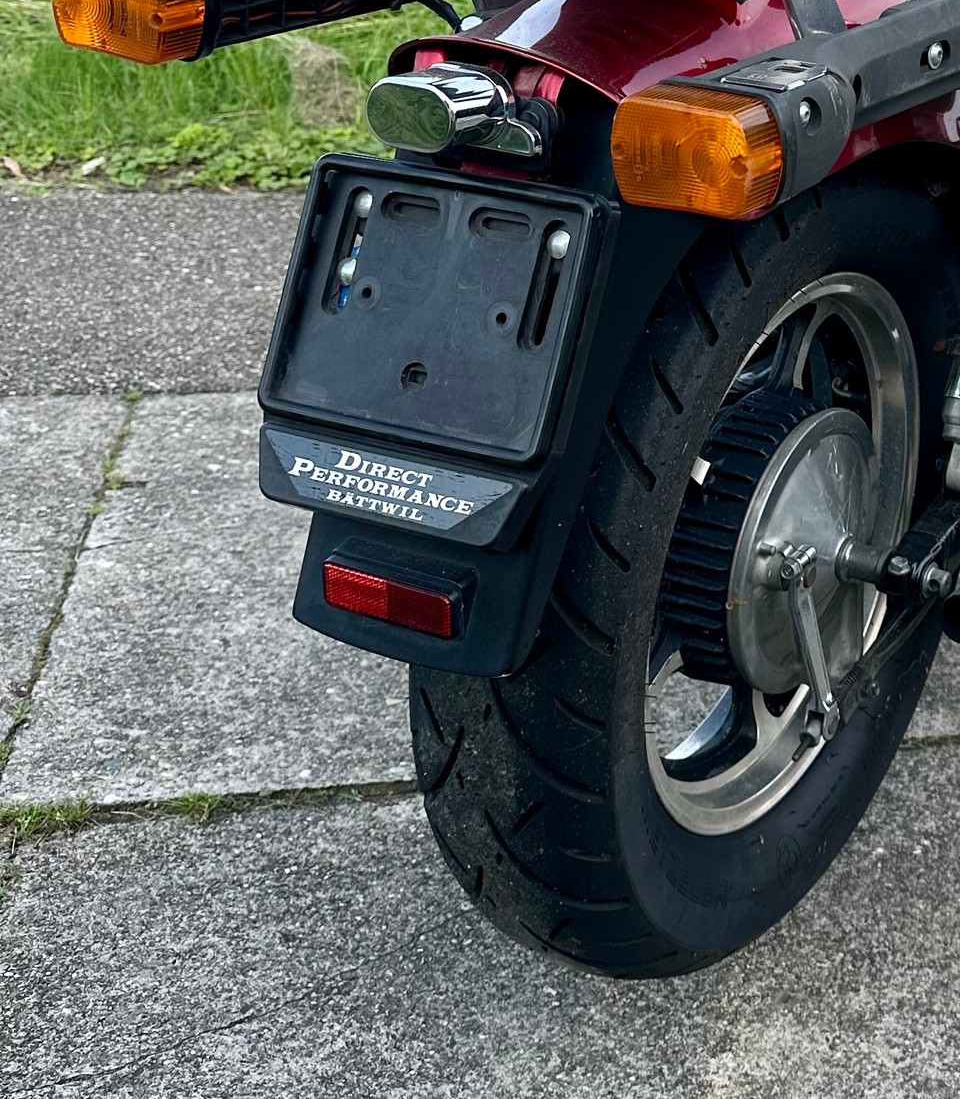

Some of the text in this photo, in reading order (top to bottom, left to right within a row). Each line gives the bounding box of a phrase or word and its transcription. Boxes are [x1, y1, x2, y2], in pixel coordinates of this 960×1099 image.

[287, 456, 475, 516] PERFORMANCE
[334, 449, 434, 488] DIRECT
[325, 488, 424, 522] BÄTTWIL
